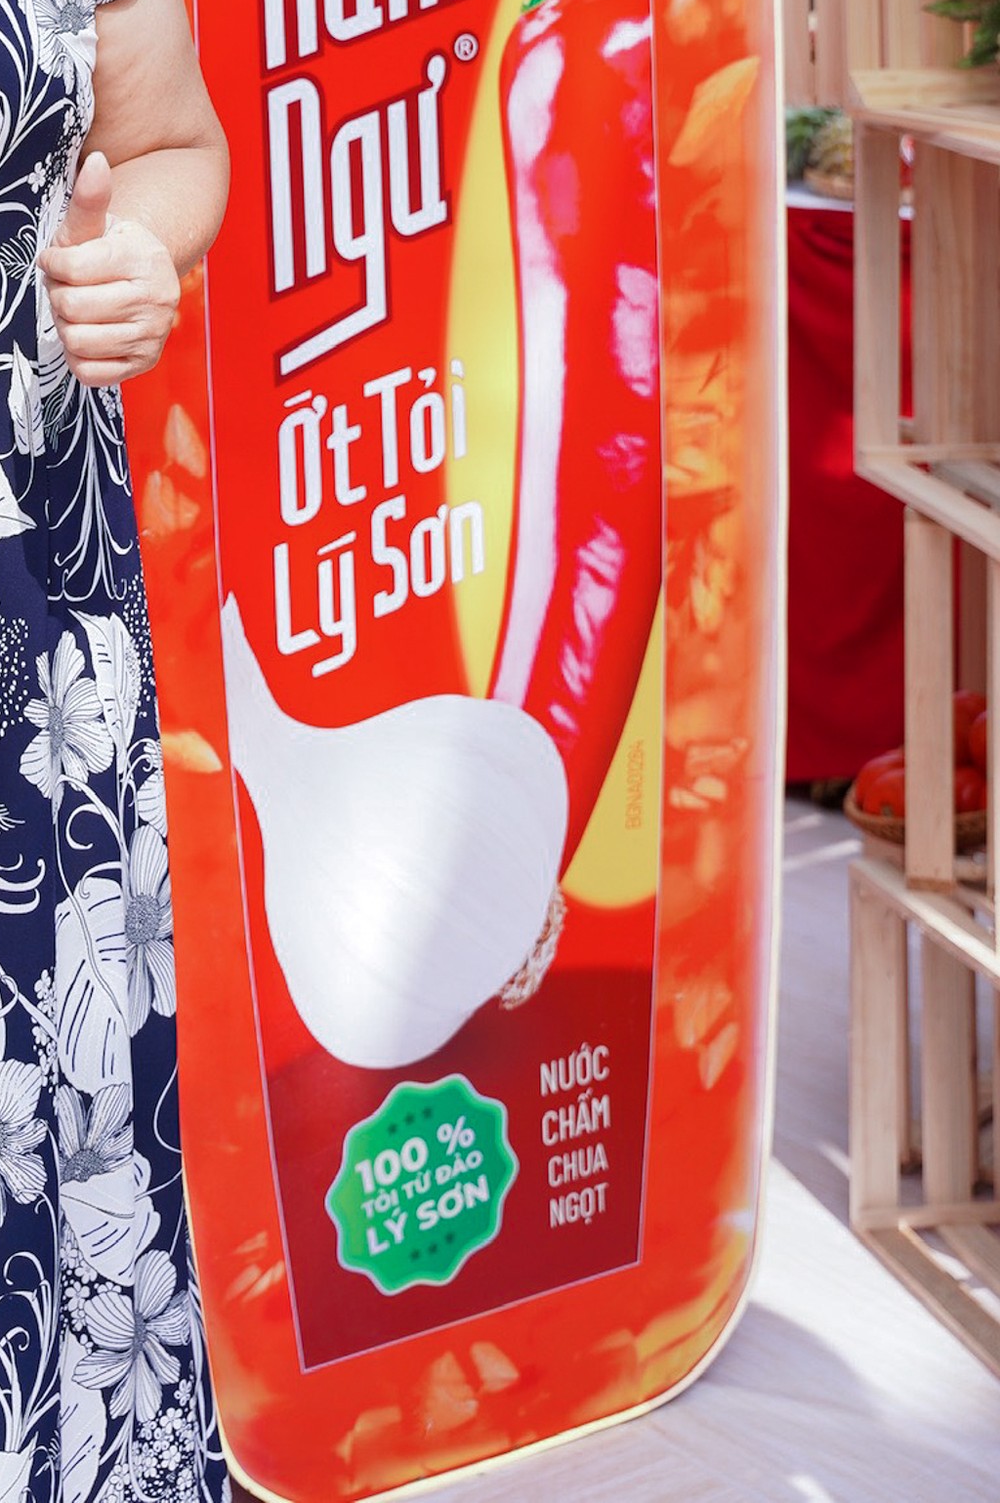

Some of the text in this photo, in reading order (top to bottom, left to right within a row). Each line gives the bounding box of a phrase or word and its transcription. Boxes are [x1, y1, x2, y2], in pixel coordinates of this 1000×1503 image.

[267, 54, 448, 376] Ngư
[363, 357, 468, 490] Tỏi
[371, 494, 486, 619] Sơn
[540, 1042, 610, 1097] NƯỚC
[541, 1087, 611, 1146] CHẤM
[354, 1115, 476, 1194] 100 %
[360, 1150, 484, 1219] TỎI TỪ ĐẢO
[548, 1143, 610, 1188] CHUA
[366, 1174, 490, 1257] LÝ SƠN
[550, 1182, 610, 1228] NGỌT
